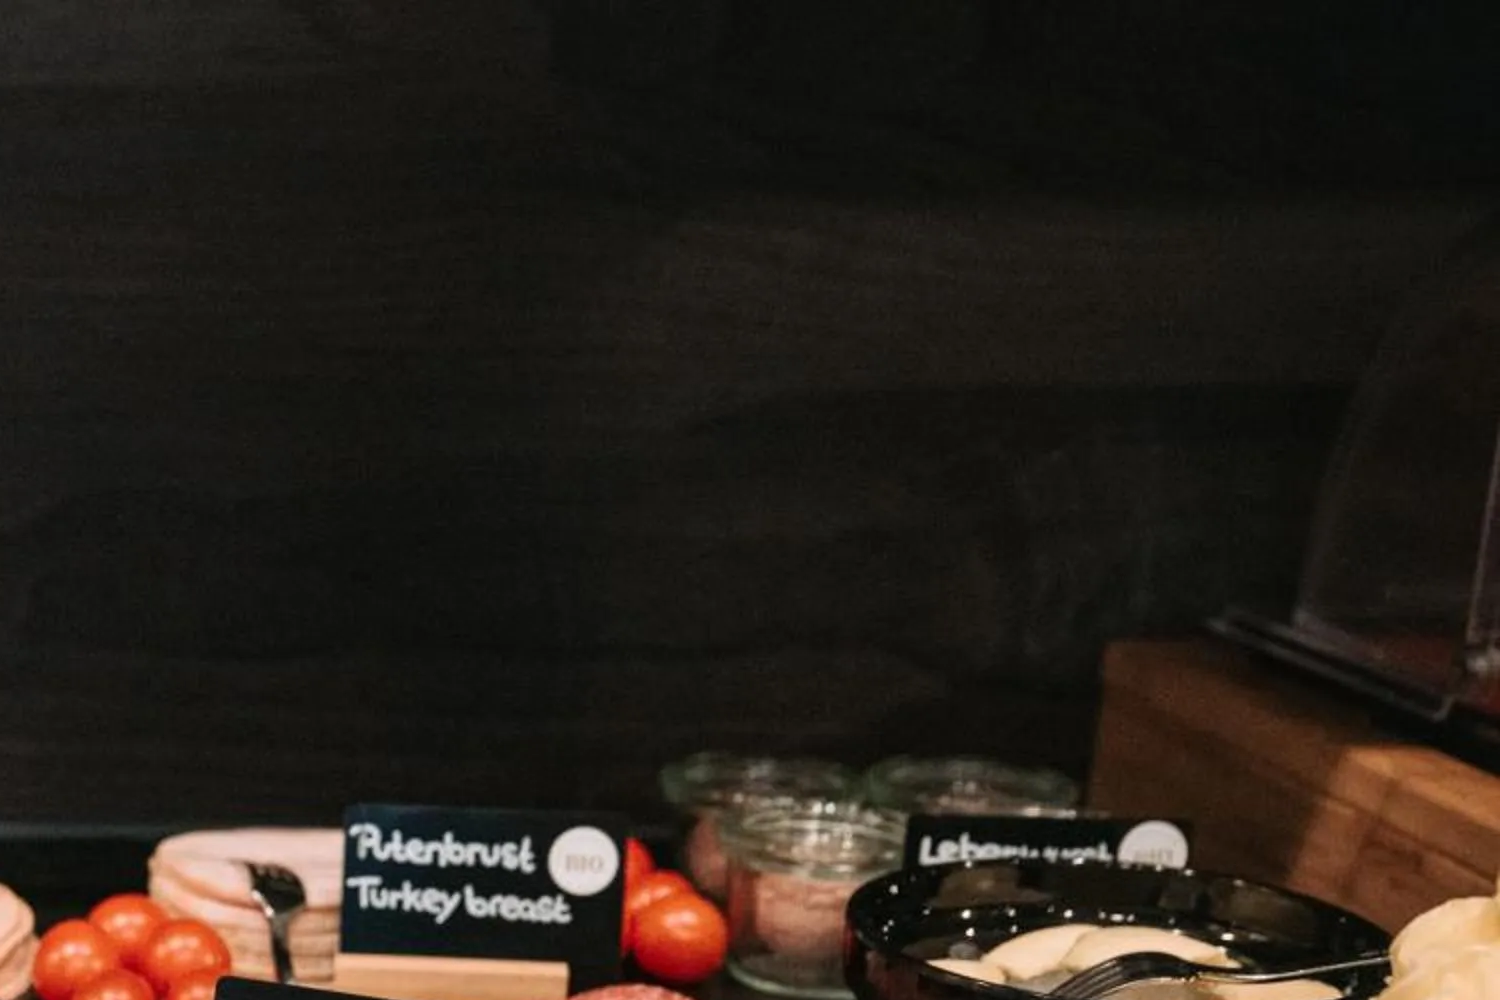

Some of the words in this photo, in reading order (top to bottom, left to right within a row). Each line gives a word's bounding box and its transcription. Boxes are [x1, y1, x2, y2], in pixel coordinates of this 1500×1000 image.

[349, 823, 535, 874] Putenbrust
[346, 876, 460, 925] Turkey
[463, 884, 573, 924] breast
